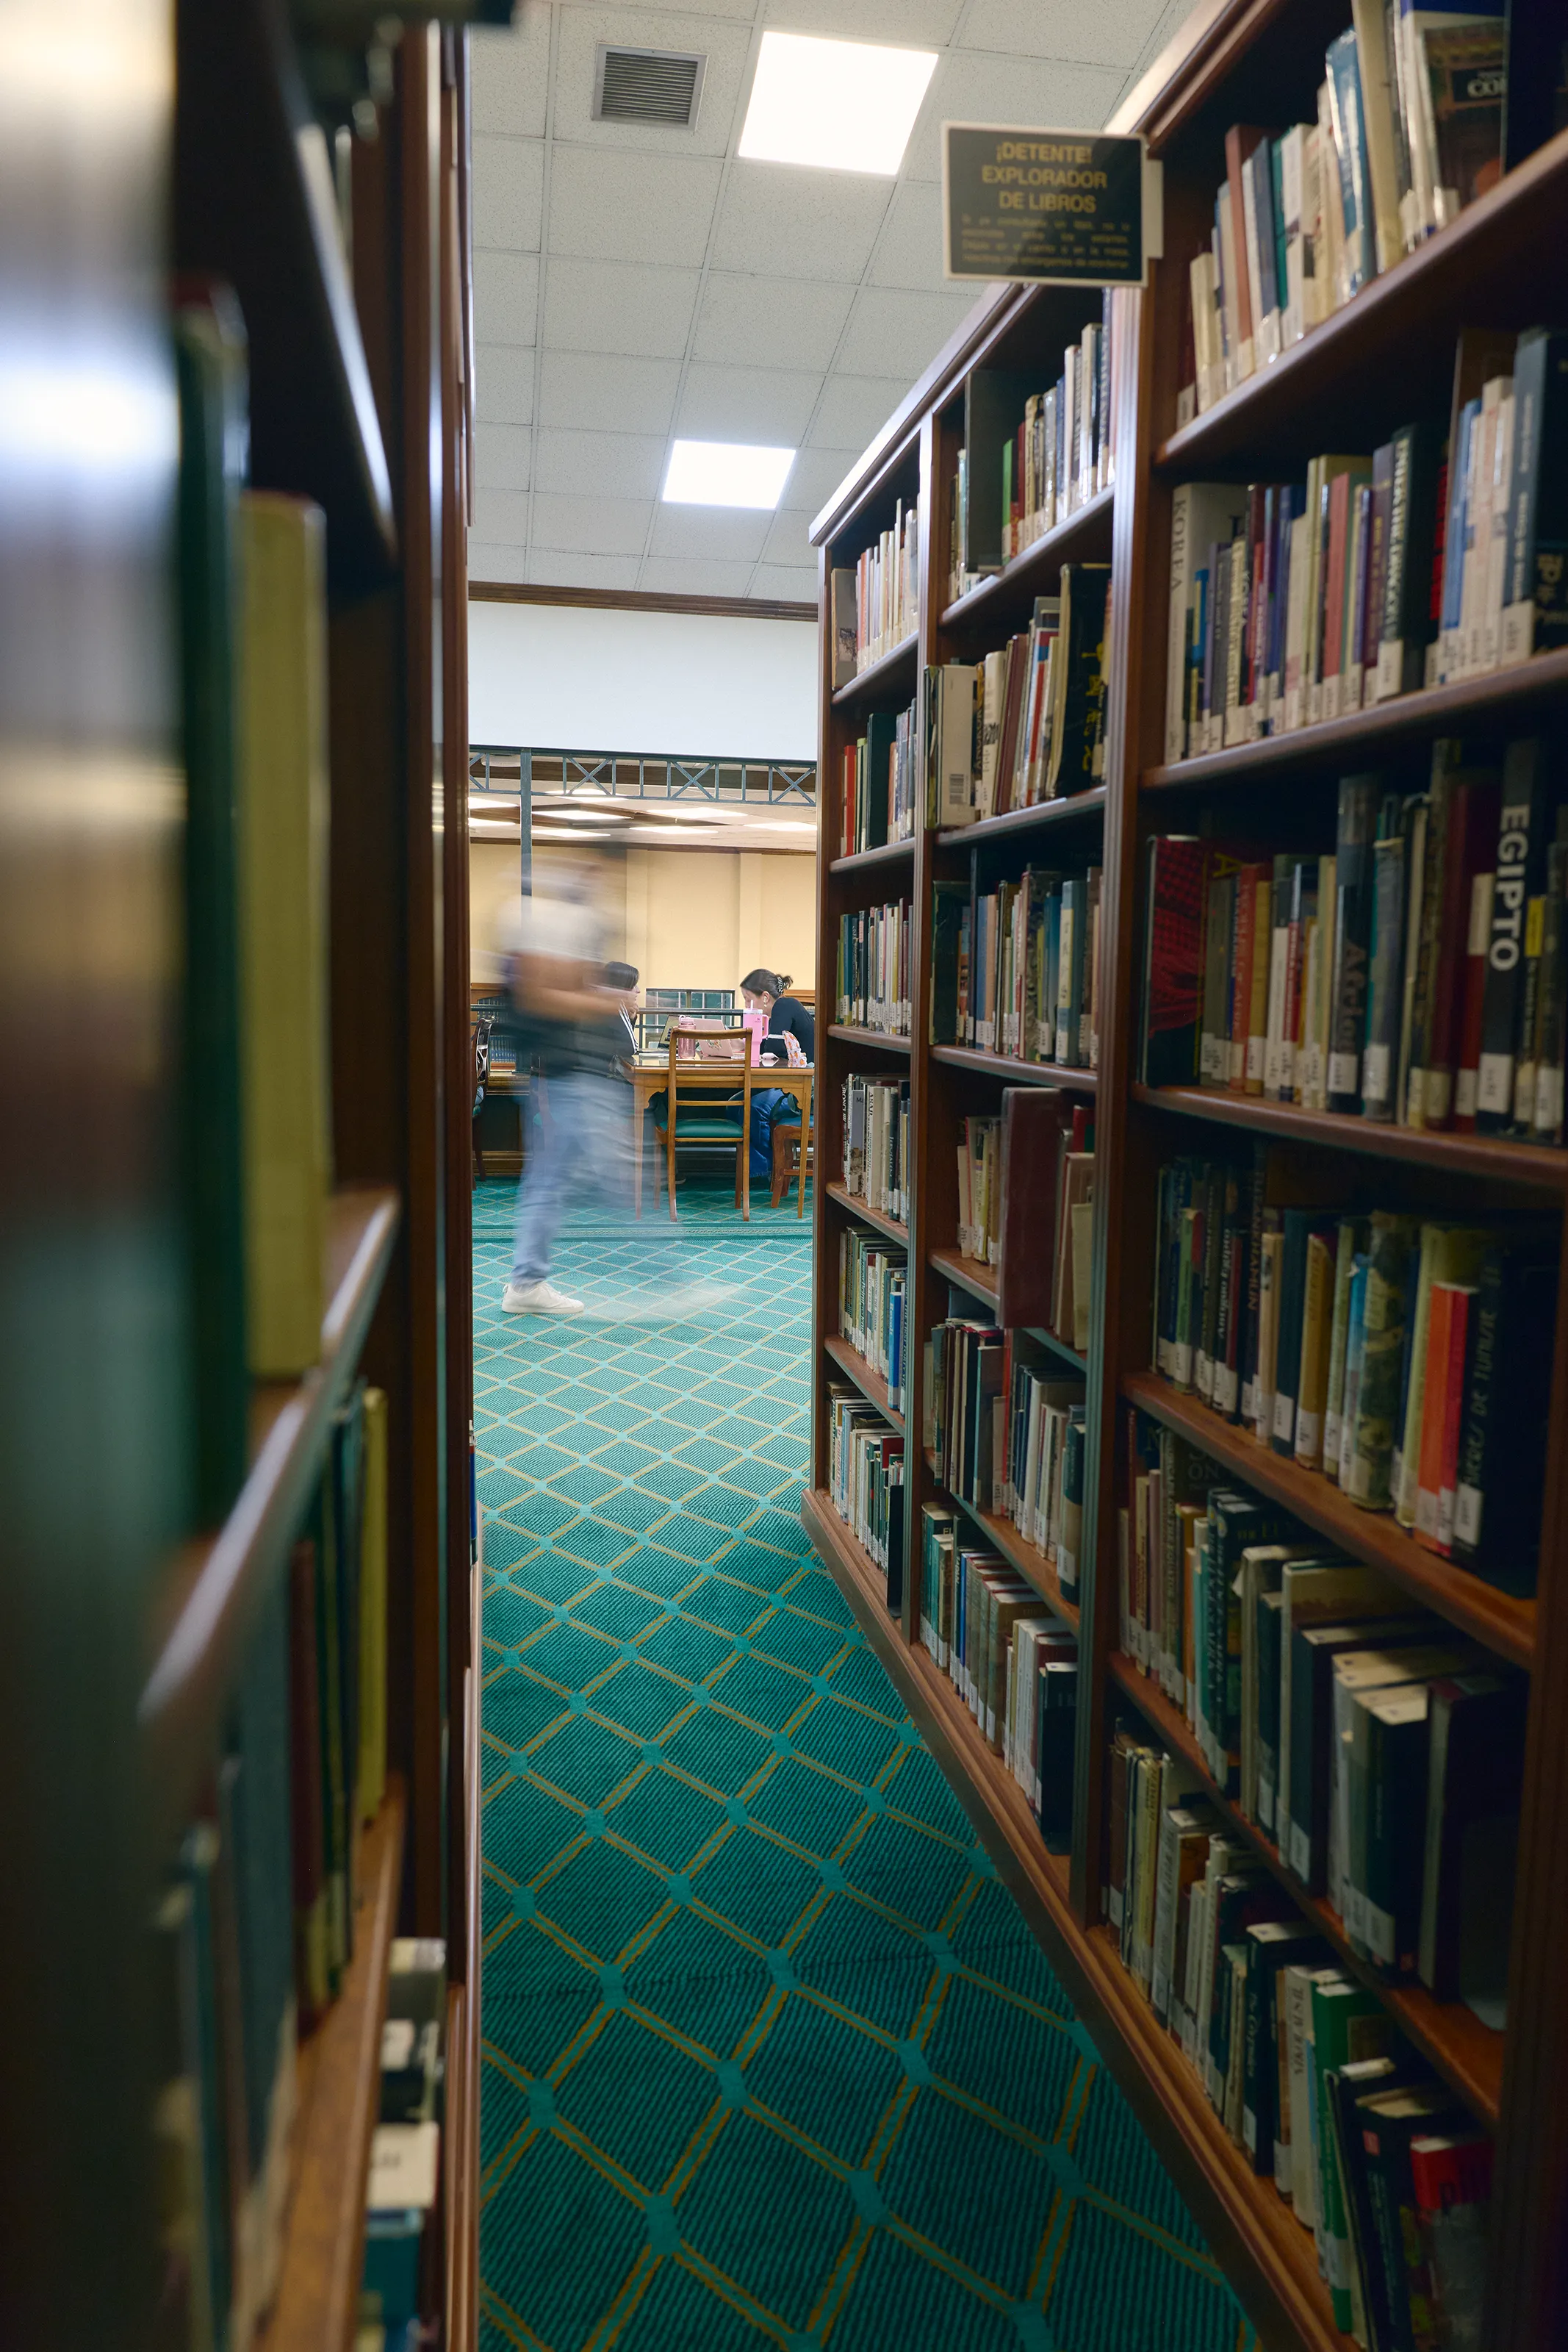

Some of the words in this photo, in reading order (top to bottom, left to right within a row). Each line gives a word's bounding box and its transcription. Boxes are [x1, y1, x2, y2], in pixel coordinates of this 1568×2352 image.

[996, 141, 1092, 163] ¡DETENTE!
[982, 165, 1107, 188] EXPLORADOR
[999, 190, 1024, 209] DE
[1029, 192, 1096, 213] LIBROS
[1171, 500, 1187, 593] KOREA
[1491, 804, 1531, 971] EGIPTO
